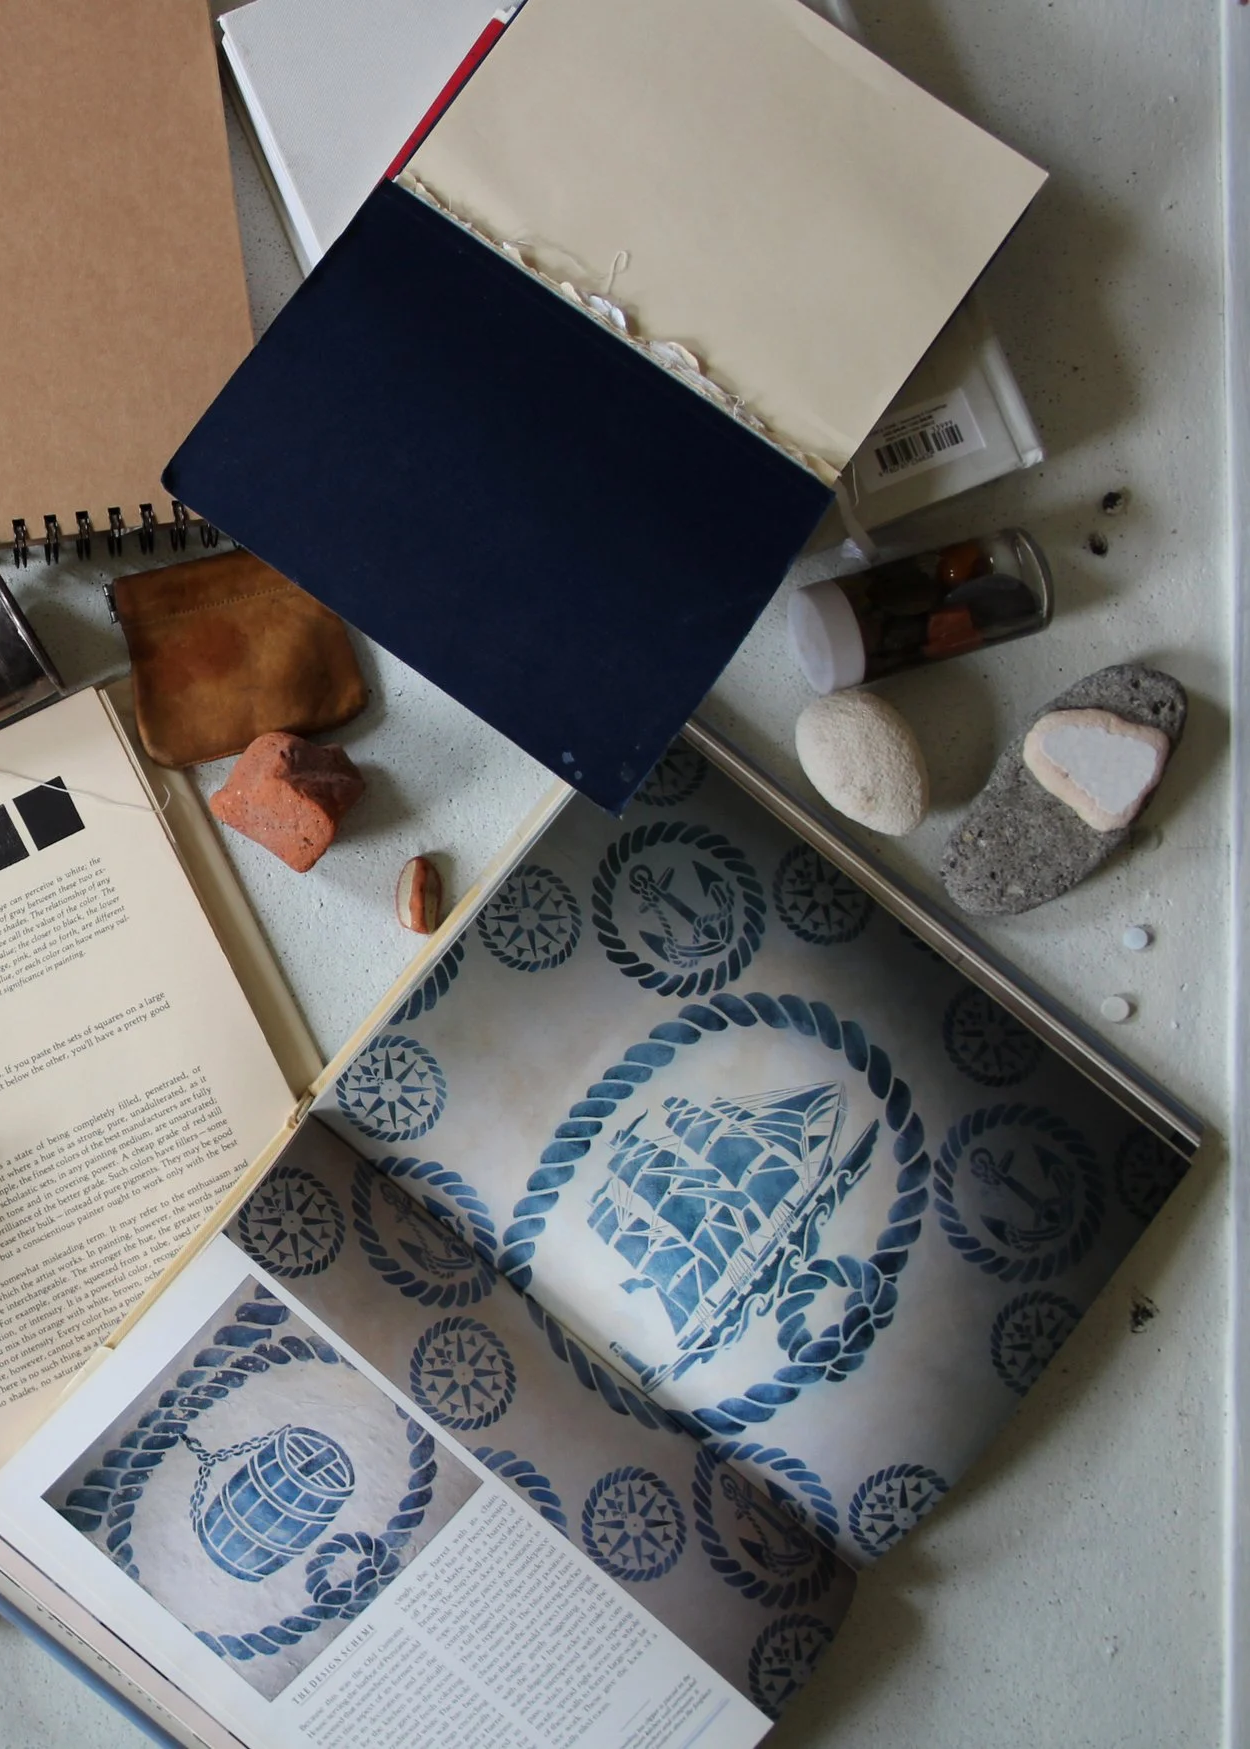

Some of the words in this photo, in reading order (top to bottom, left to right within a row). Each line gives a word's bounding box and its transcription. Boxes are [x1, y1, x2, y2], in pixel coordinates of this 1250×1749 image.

[9, 895, 23, 906] can
[24, 880, 55, 900] perceive
[64, 864, 88, 879] white;
[88, 856, 101, 867] the
[3, 1064, 13, 1075] If
[13, 1058, 31, 1073] you
[30, 1047, 52, 1065] paste
[51, 1040, 67, 1052] the
[66, 1032, 83, 1045] sets
[82, 1024, 93, 1037] of
[93, 1012, 125, 1031] squares
[125, 1006, 138, 1016] on
[138, 1002, 145, 1010] a
[143, 991, 166, 1007] large
[3, 1071, 30, 1088] below
[30, 1064, 45, 1075] the
[45, 1052, 70, 1068] other,
[93, 1029, 115, 1044] have
[122, 1013, 148, 1032] pretty
[149, 999, 171, 1019] good
[13, 1148, 34, 1162] state
[35, 1140, 45, 1152] of
[45, 1130, 71, 1146] being
[72, 1107, 115, 1133] completely
[117, 1093, 143, 1111] filled,
[144, 1071, 190, 1100] penetrated,
[191, 1065, 202, 1075] or
[0, 1263, 41, 1289] somewhat
[41, 1241, 86, 1268] misleading
[85, 1231, 107, 1246] term.
[291, 1687, 311, 1705] THE
[308, 1656, 343, 1689] DESIGN
[340, 1623, 376, 1658] SCHEME
